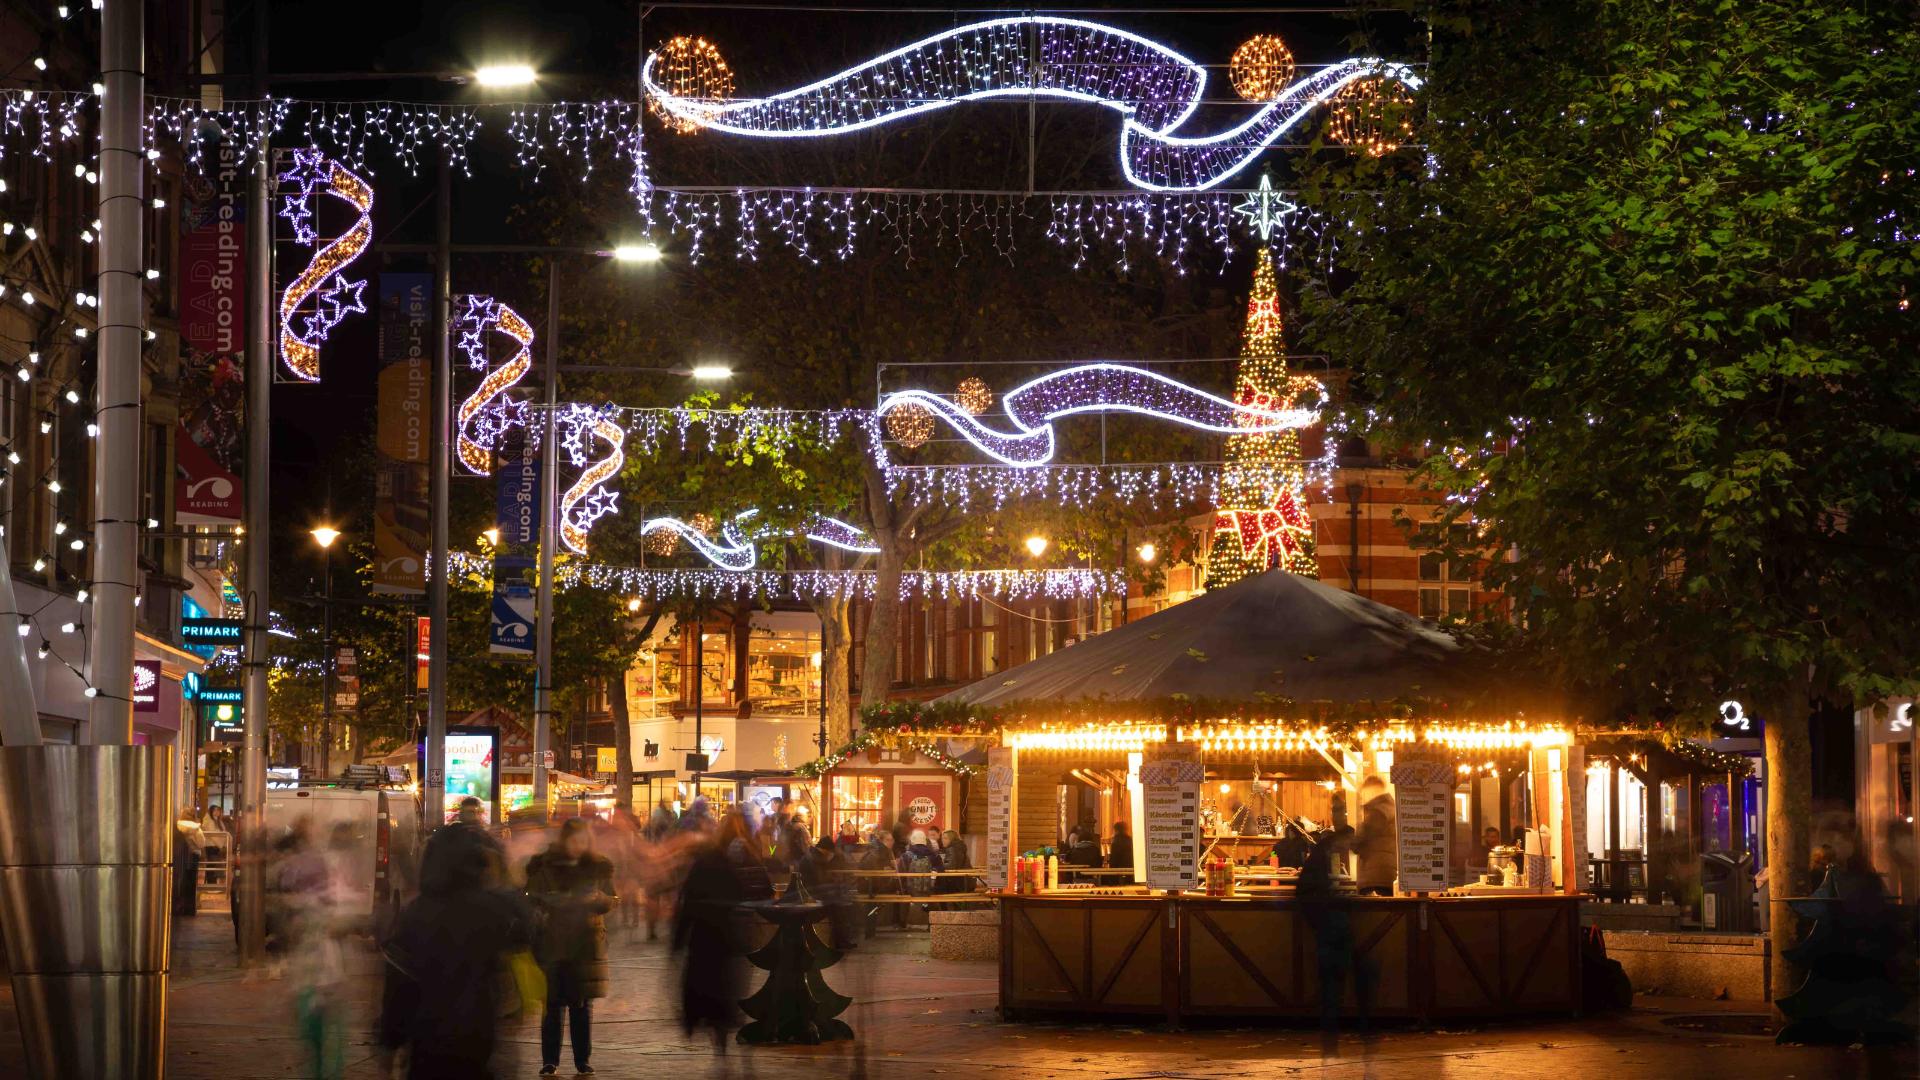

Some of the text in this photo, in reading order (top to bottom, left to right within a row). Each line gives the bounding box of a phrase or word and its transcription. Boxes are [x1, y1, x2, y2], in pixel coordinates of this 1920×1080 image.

[402, 285, 426, 460] visit-reading.com
[182, 626, 240, 637] PRIMARK
[200, 692, 242, 701] PRIMARK
[1719, 700, 1750, 730] O2
[910, 805, 940, 813] ONUTS
